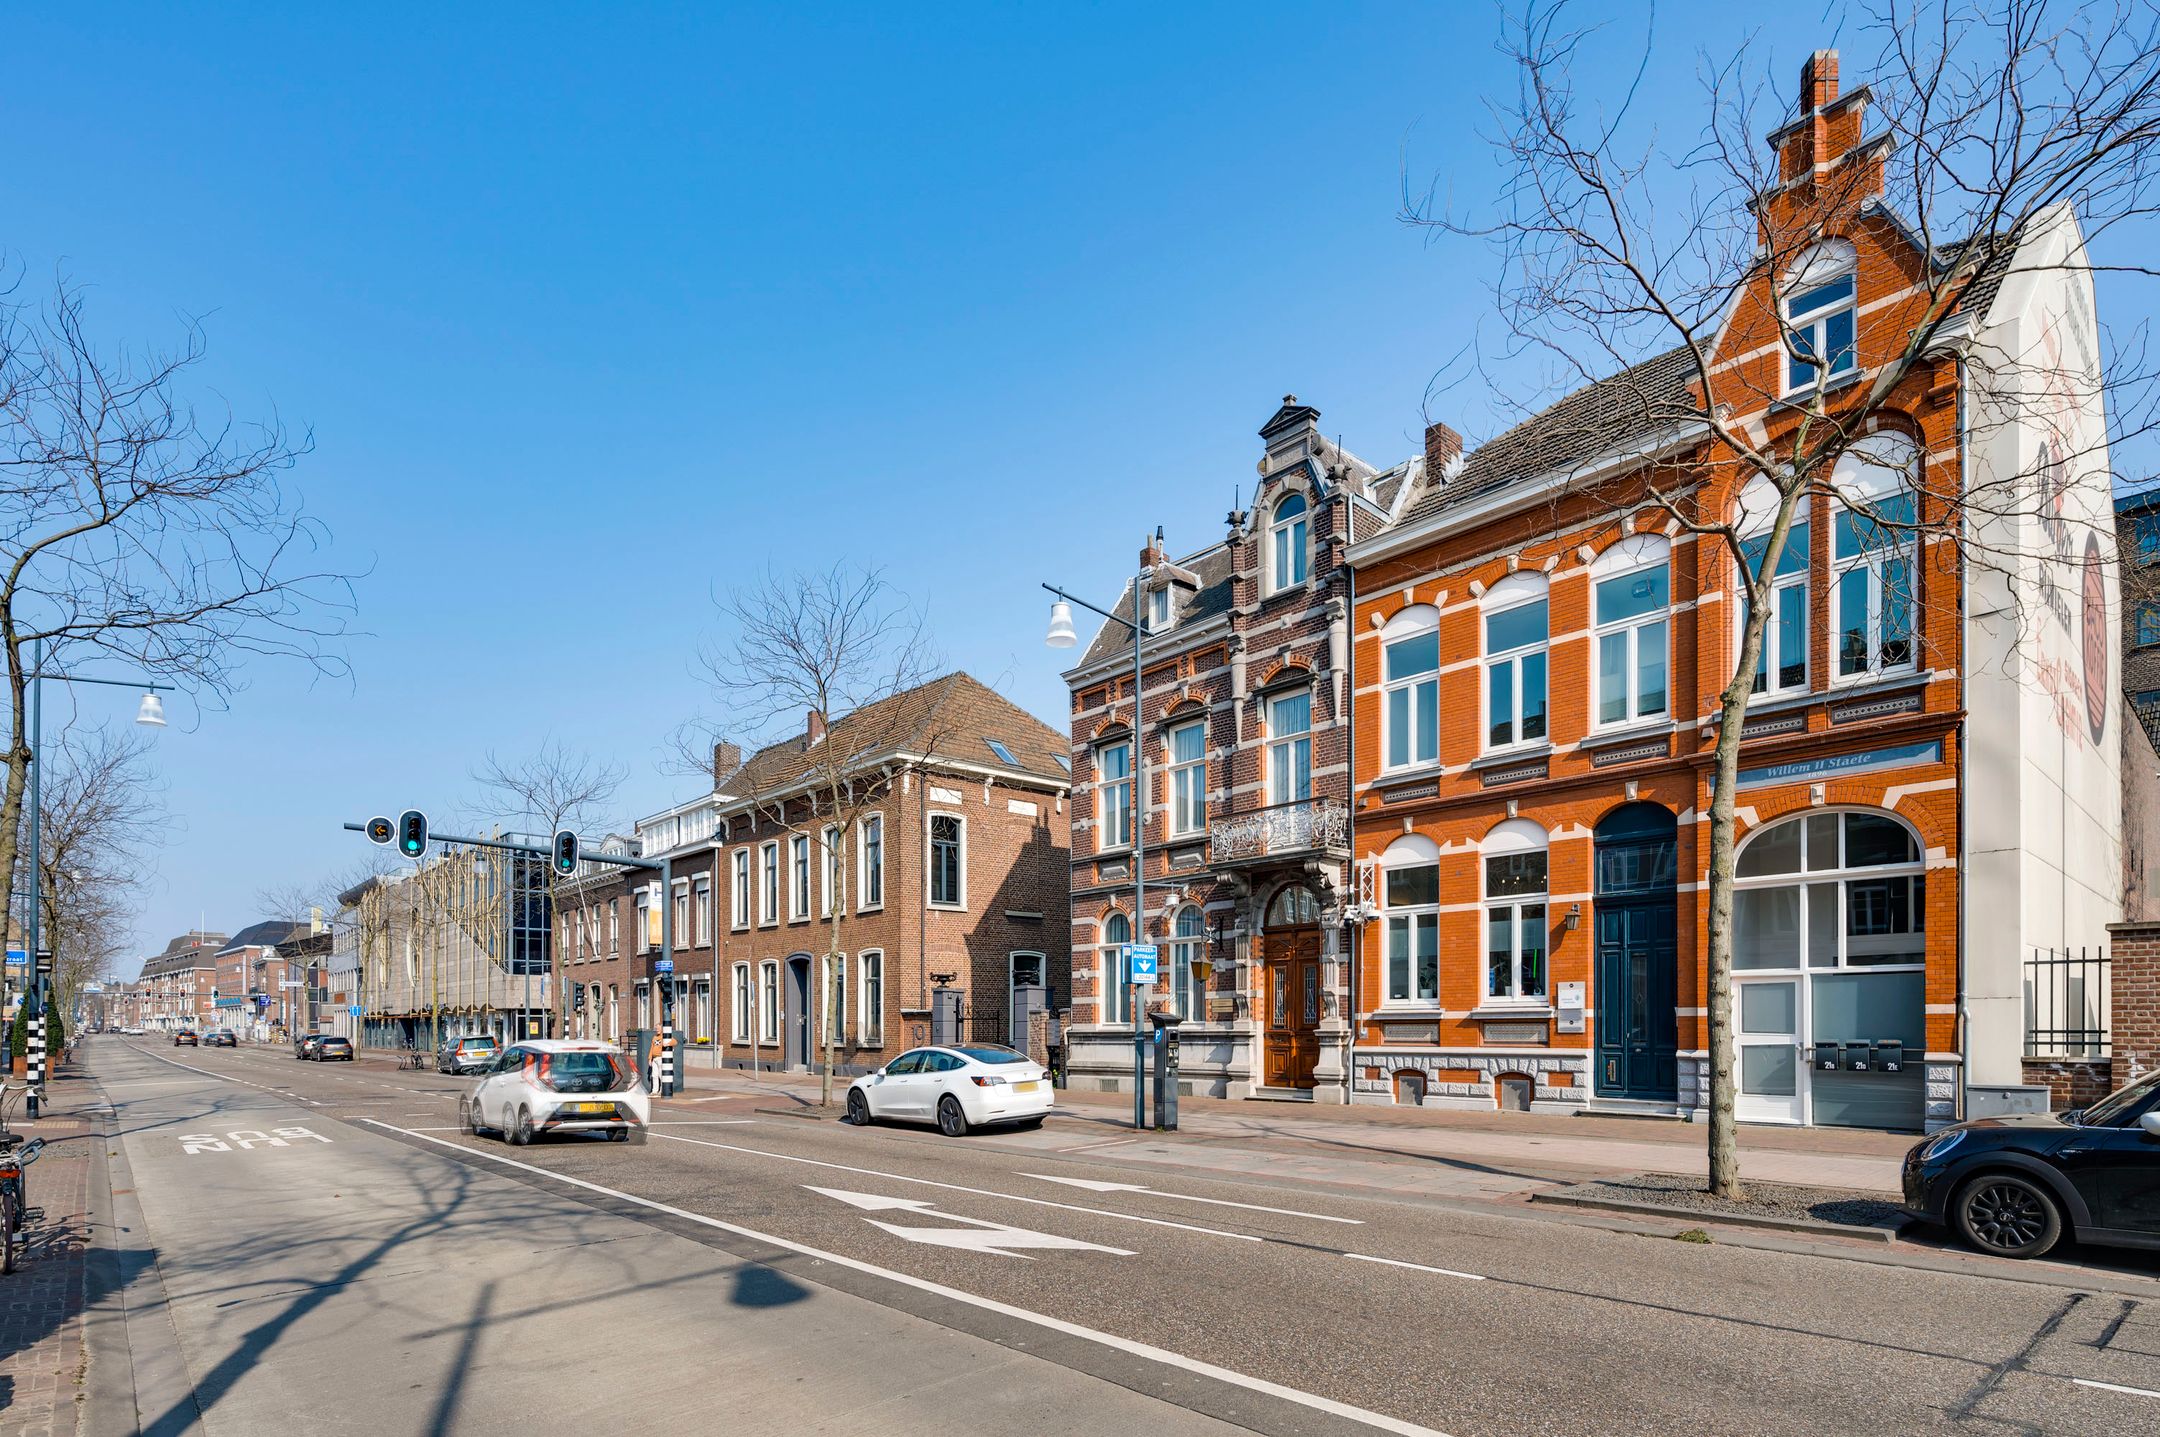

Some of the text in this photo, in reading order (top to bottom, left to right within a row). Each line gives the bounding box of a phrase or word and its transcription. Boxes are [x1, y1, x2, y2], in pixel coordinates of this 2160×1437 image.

[1767, 763, 1810, 777] Willem
[1828, 754, 1871, 769] Staete
[1155, 1029, 1161, 1040] P
